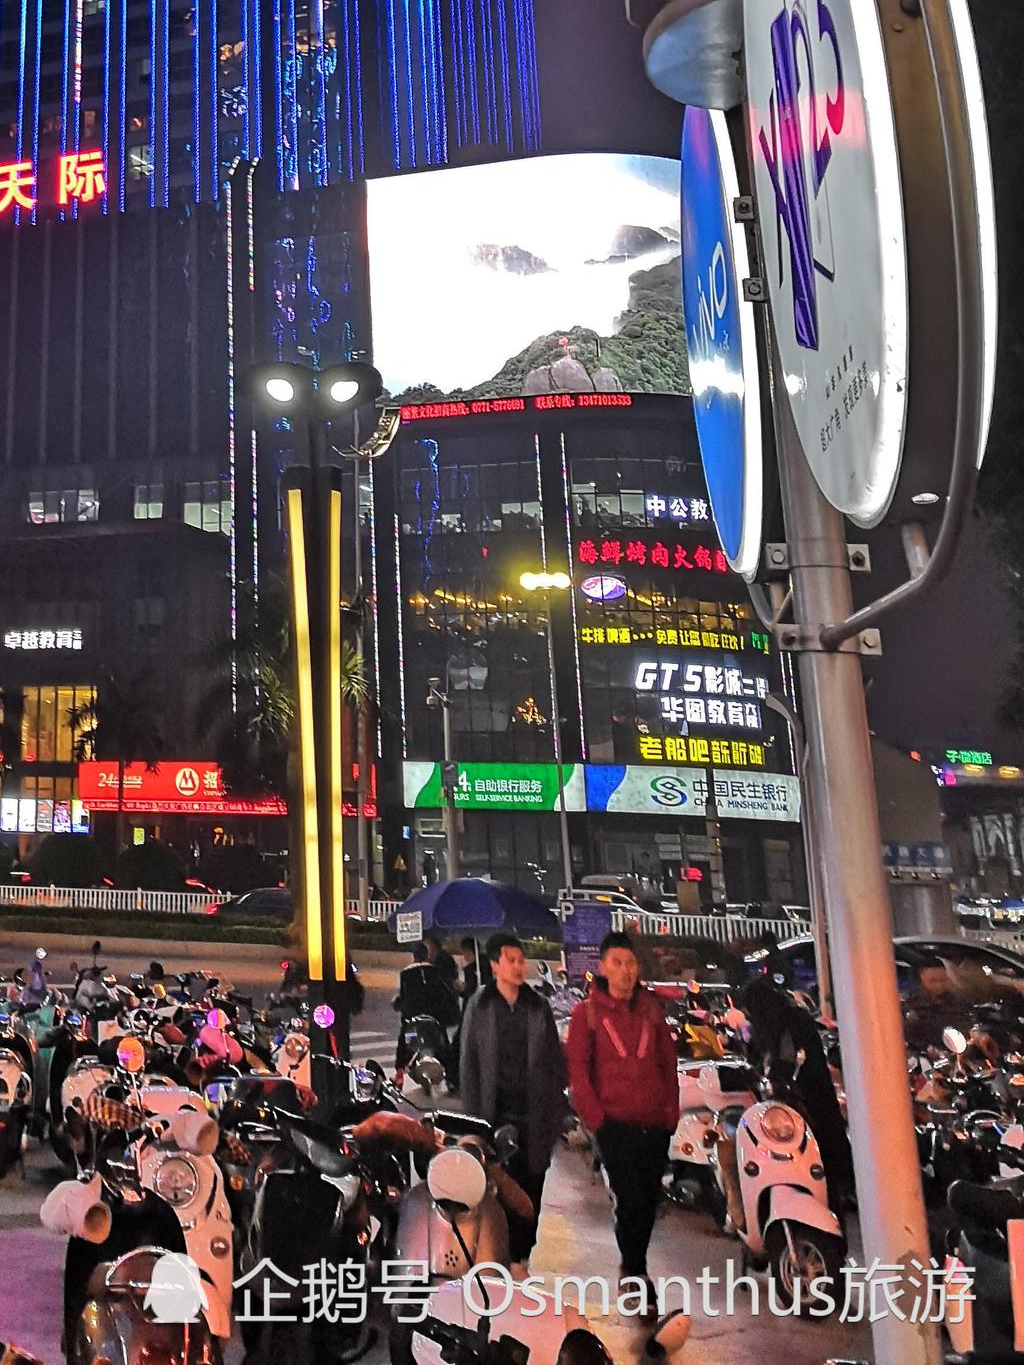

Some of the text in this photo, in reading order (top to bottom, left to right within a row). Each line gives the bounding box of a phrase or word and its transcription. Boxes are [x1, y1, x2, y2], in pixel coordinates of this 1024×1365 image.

[475, 778, 543, 794] 自助银行服务
[692, 778, 788, 802] 中国民生银行
[727, 799, 769, 811] MINSHENG
